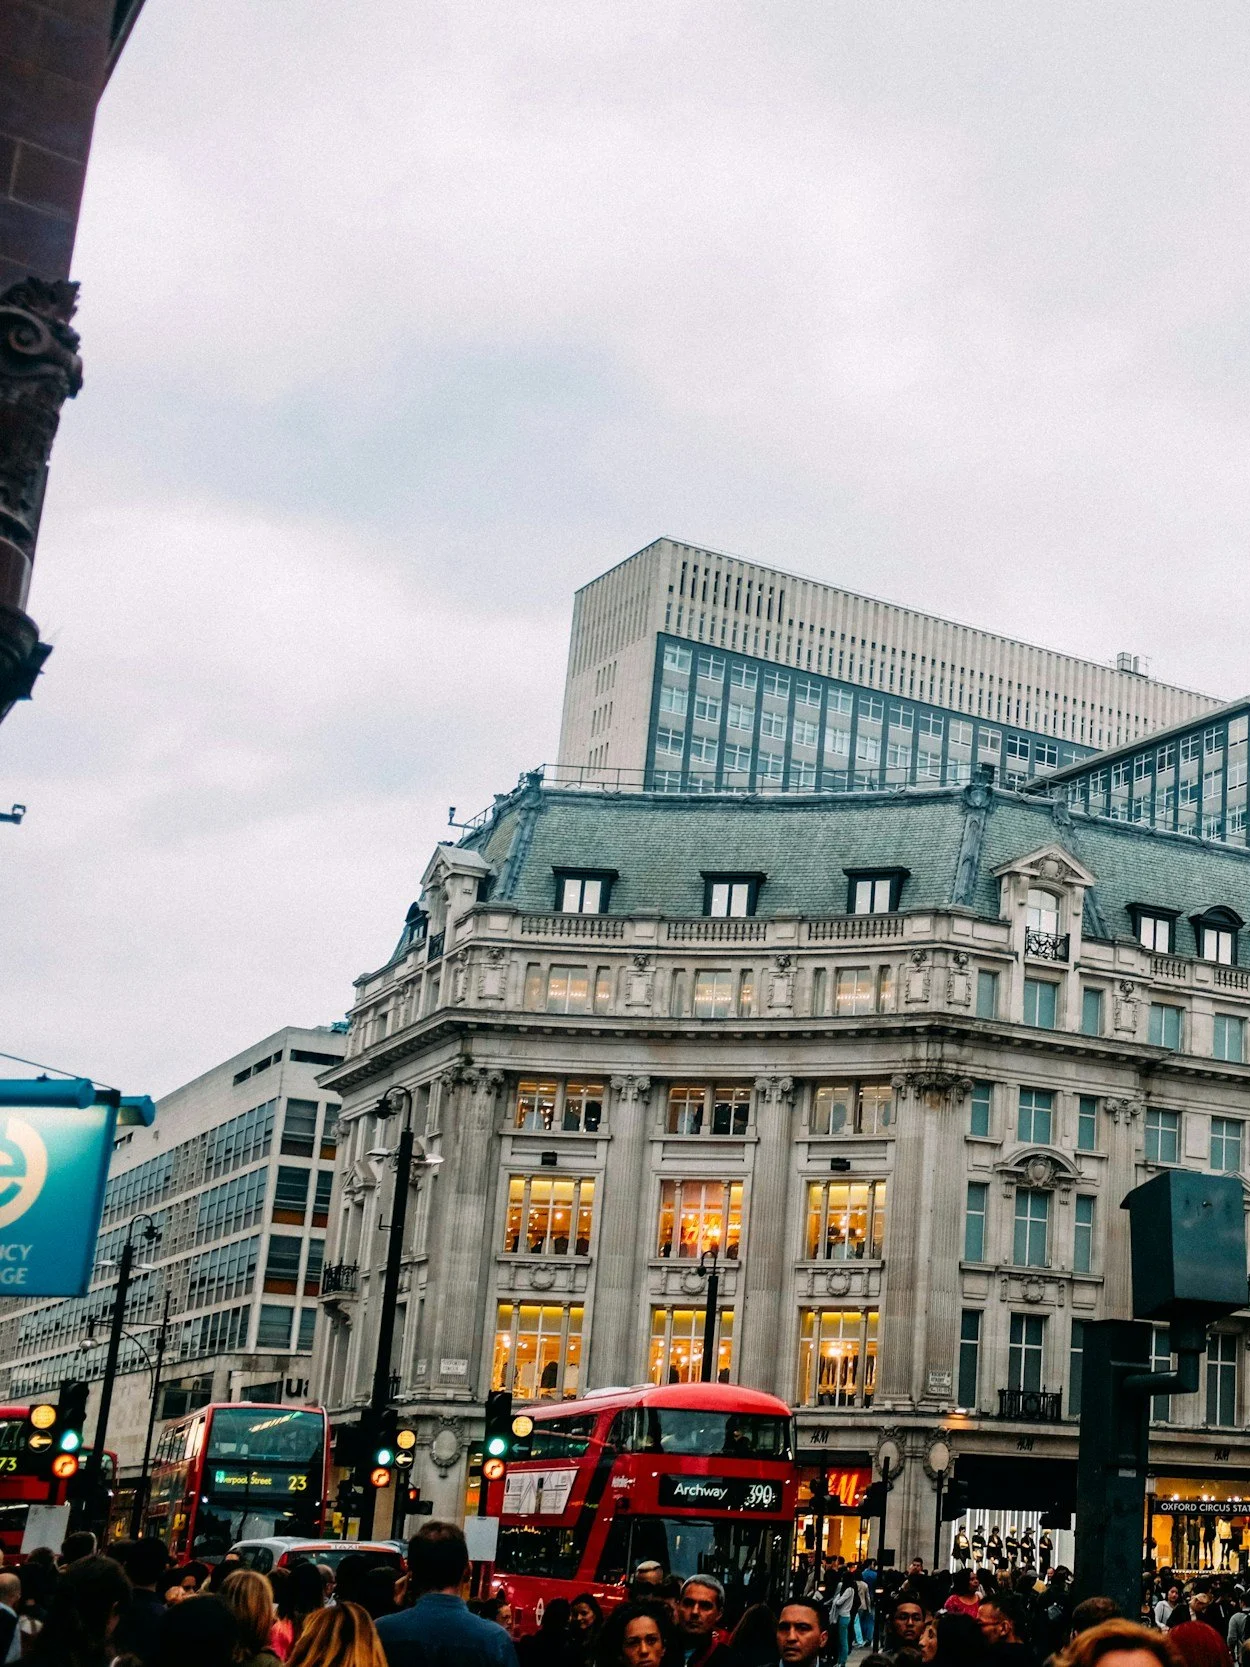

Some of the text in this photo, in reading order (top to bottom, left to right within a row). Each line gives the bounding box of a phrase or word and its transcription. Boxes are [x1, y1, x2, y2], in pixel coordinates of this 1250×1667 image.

[250, 1475, 272, 1485] Street
[288, 1475, 307, 1490] 23
[674, 1482, 728, 1500] Archway
[748, 1484, 773, 1504] 390
[1161, 1502, 1197, 1512] OXFORD
[1199, 1502, 1231, 1513] CIRCUS
